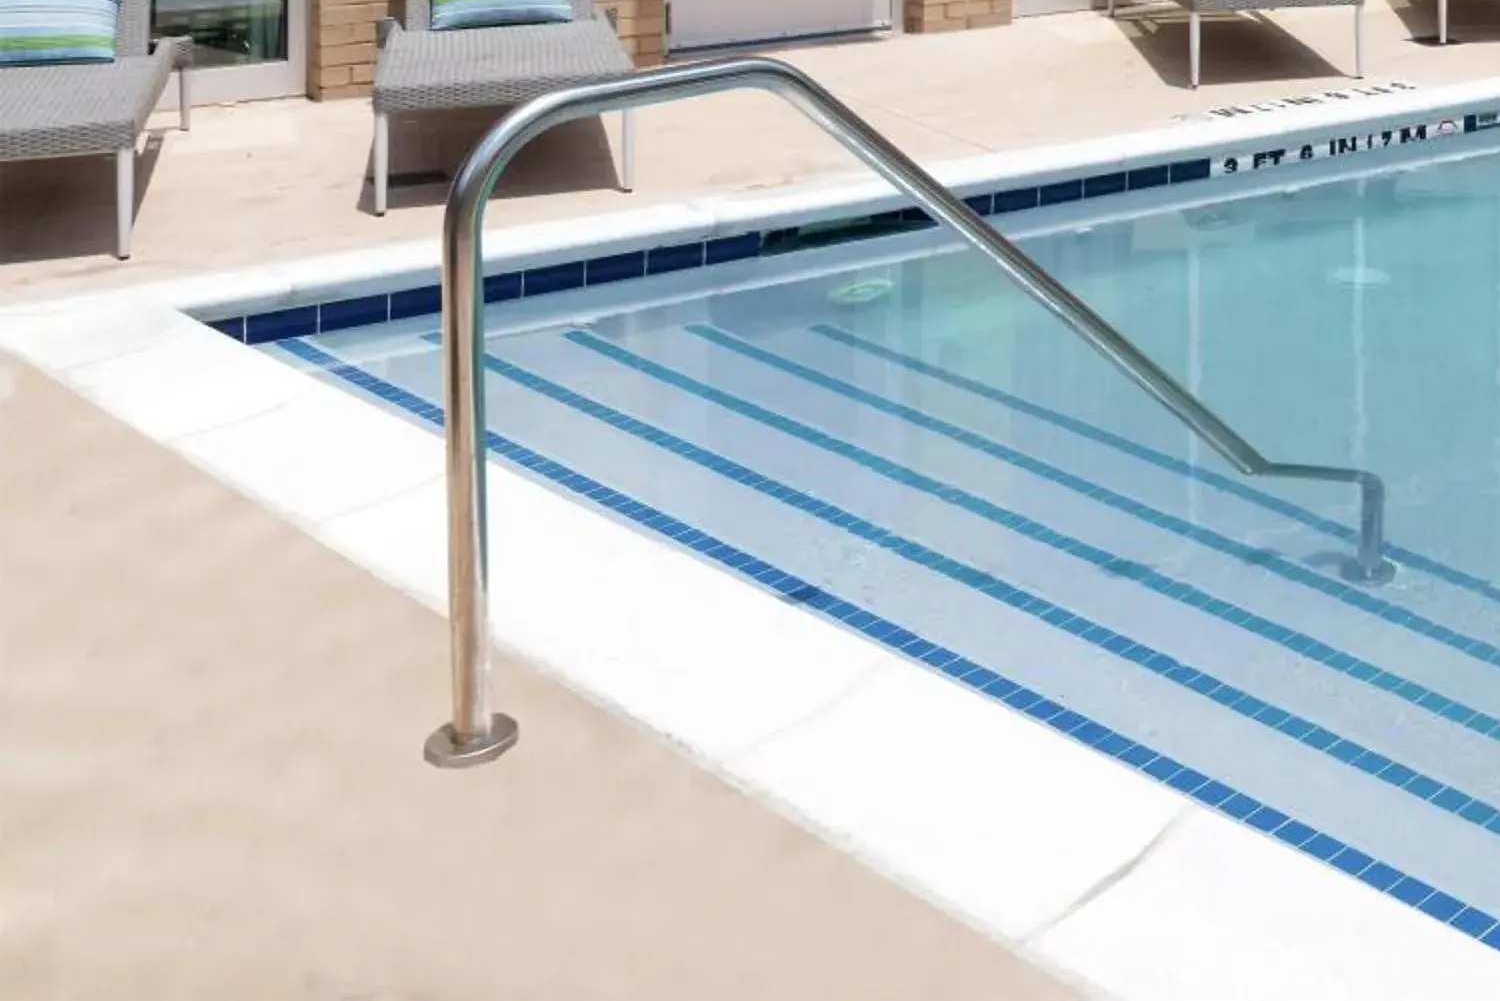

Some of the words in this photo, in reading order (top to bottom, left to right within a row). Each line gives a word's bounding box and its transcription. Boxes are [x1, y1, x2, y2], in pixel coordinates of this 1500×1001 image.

[1253, 149, 1286, 169] FT
[1329, 137, 1357, 156] IN
[1400, 124, 1427, 143] M
